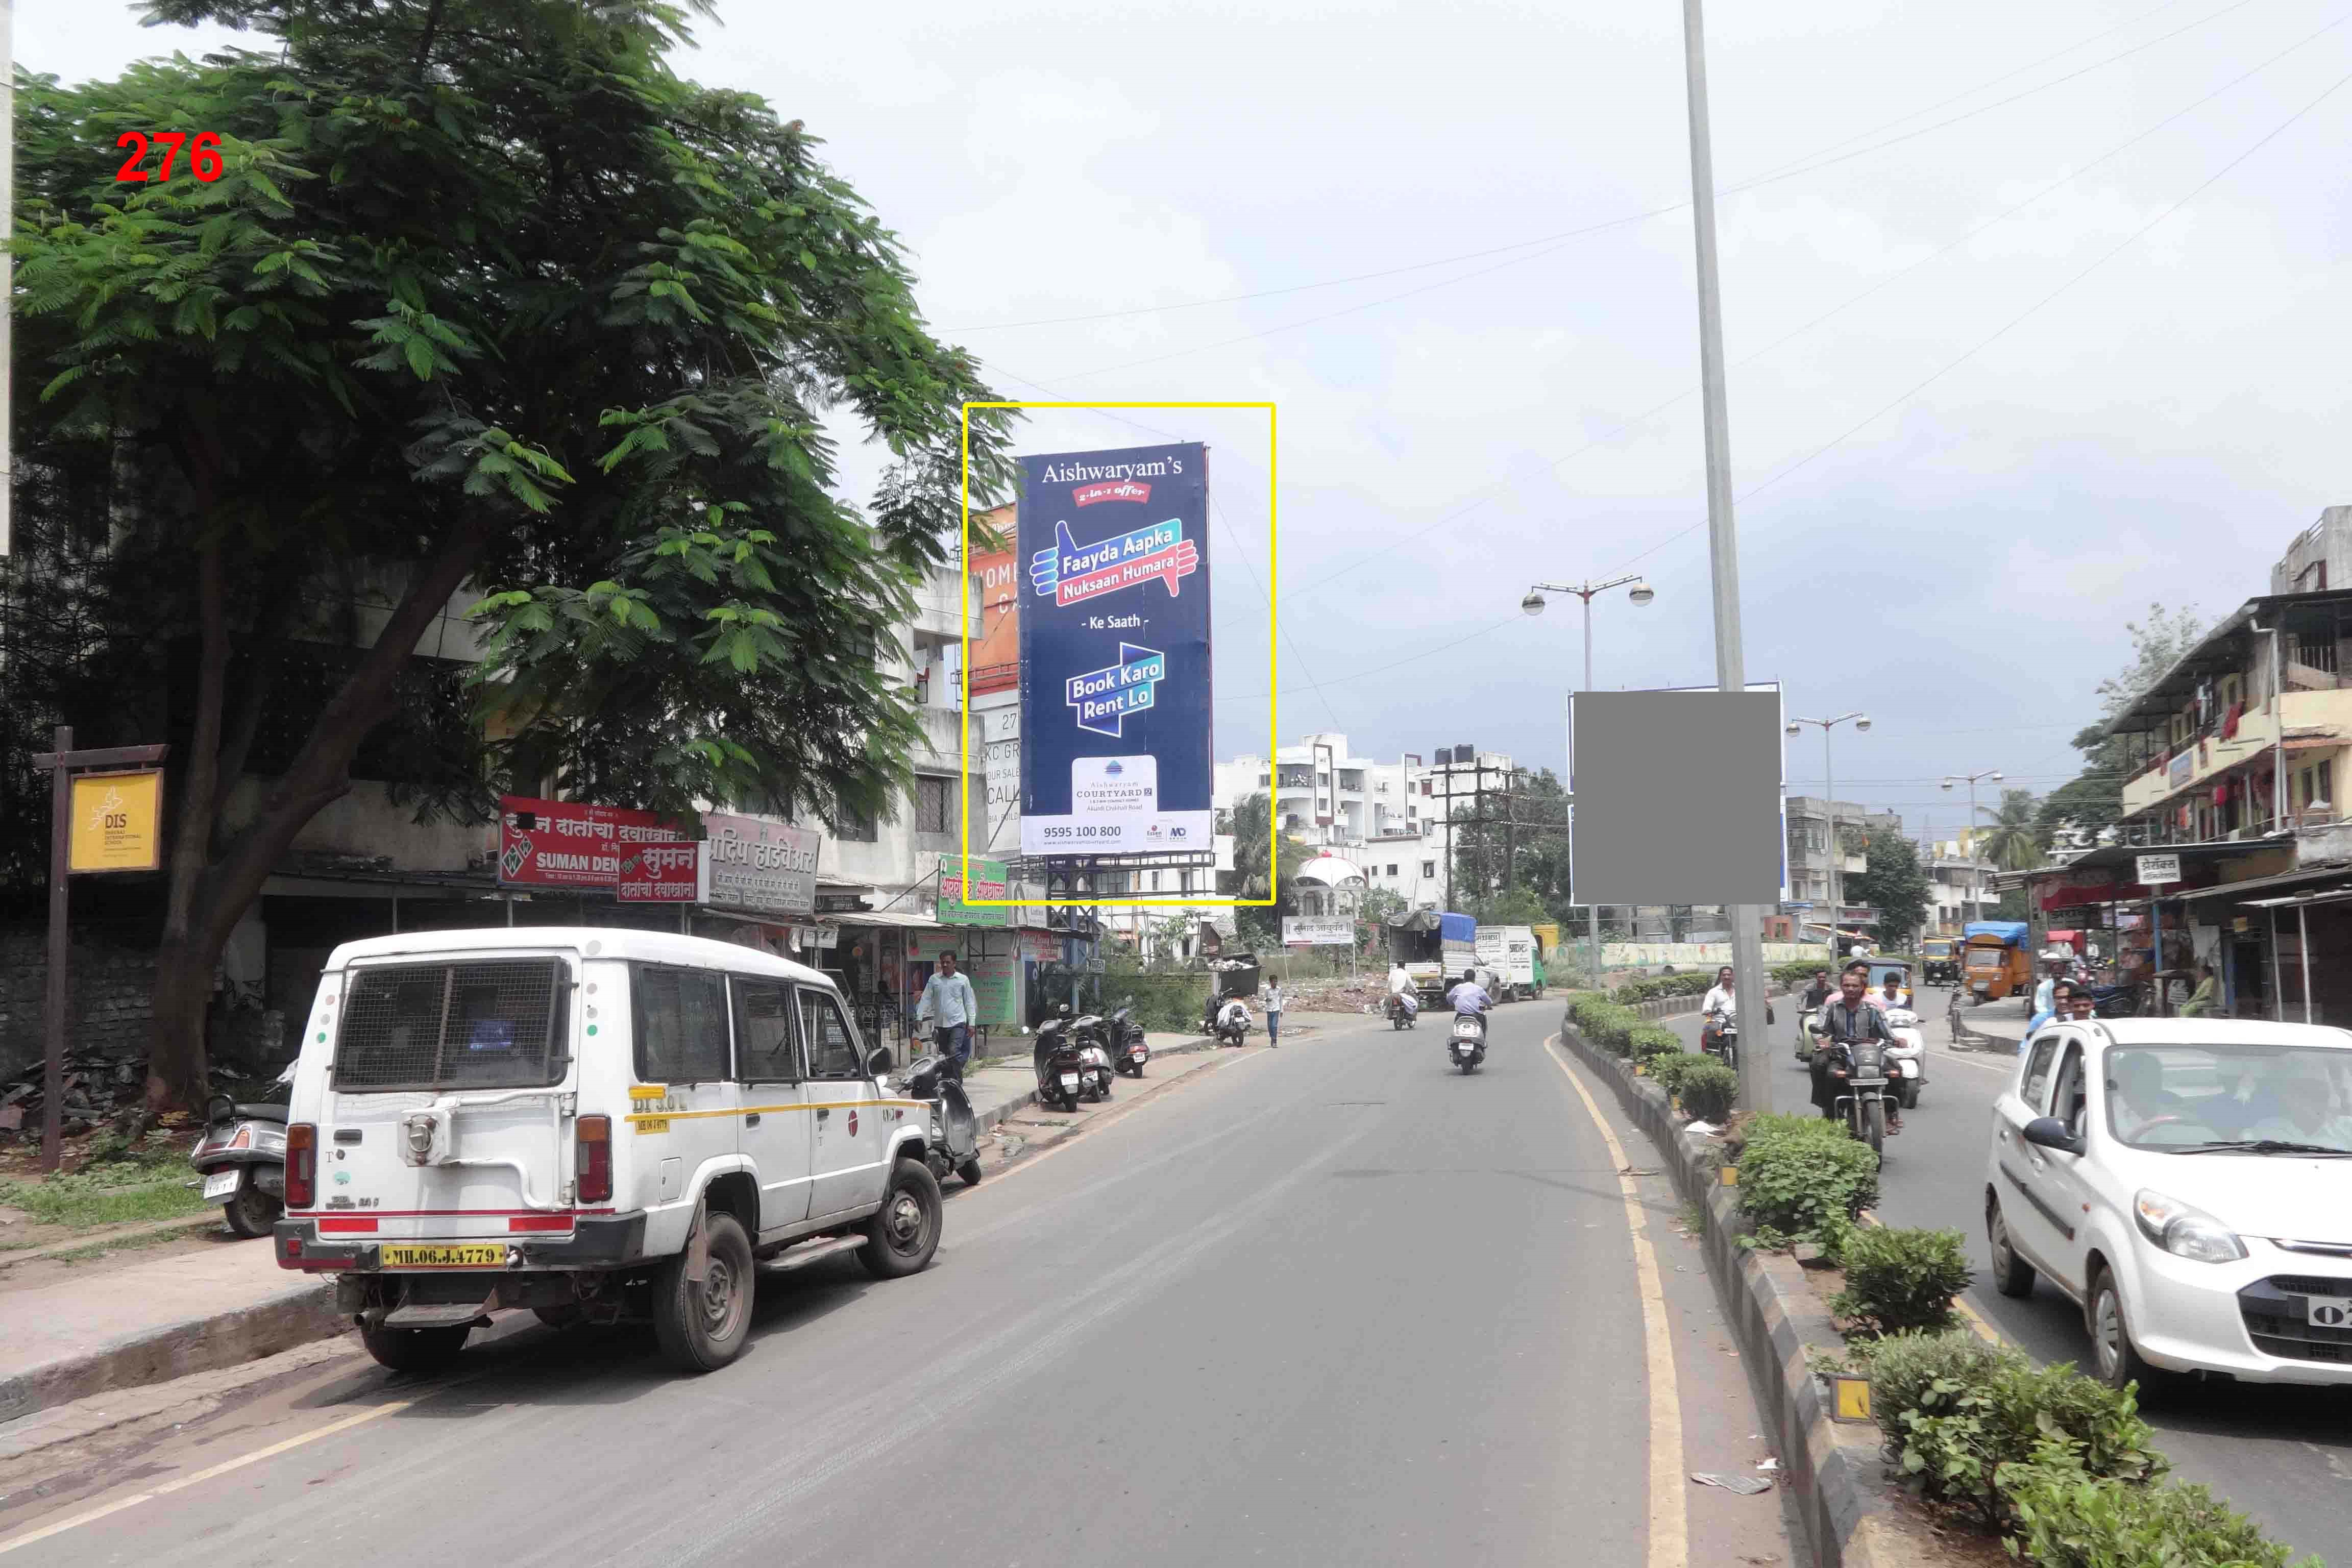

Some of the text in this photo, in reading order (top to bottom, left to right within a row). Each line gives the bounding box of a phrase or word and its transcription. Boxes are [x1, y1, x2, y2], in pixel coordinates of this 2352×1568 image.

[1042, 456, 1183, 482] Aishwaryam's
[1114, 484, 1145, 497] offer
[1063, 529, 1173, 574] Faayda Aapka
[1063, 556, 1174, 600] Nuksaan Humara
[1089, 614, 1141, 629] Ke Saath
[1073, 664, 1159, 698] Book Karo
[1084, 689, 1148, 719] Rent Lo
[1002, 767, 1020, 778] SALE
[1076, 789, 1142, 797] COURTYARD
[105, 814, 127, 828] DIS
[1001, 812, 1020, 822] BUILD
[1044, 826, 1121, 838] 9595 100 800
[536, 852, 589, 871] SUMAN
